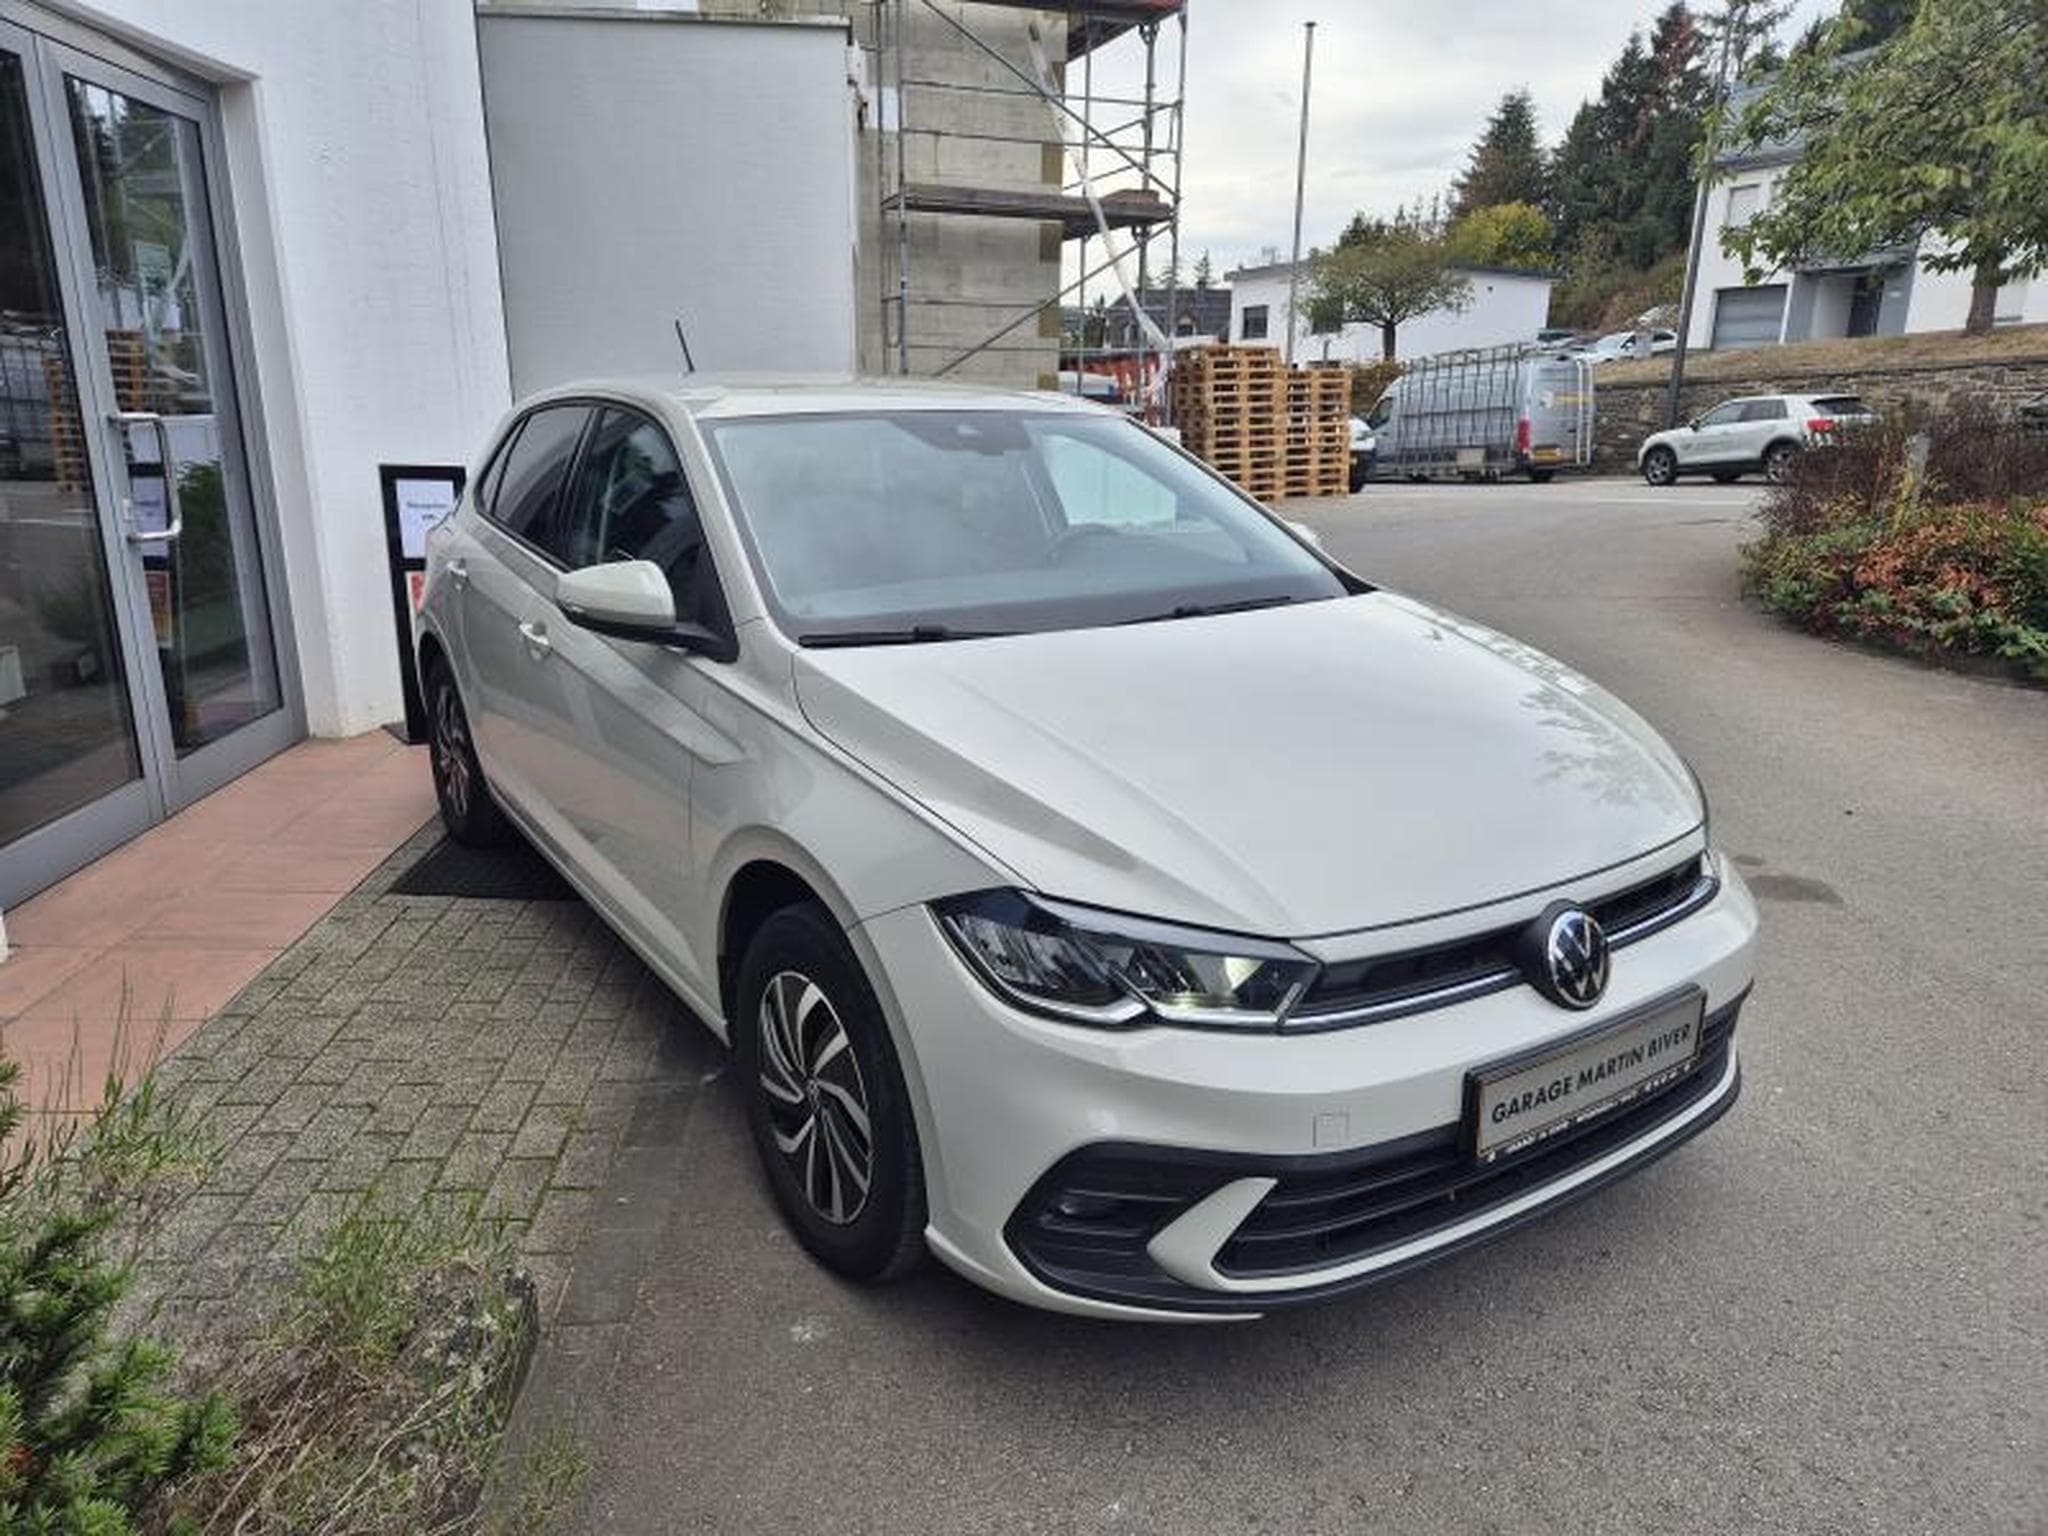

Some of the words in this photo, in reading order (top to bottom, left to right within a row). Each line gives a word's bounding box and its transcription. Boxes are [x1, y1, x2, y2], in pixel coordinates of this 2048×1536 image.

[1492, 1076, 1573, 1124] GARAGE
[1577, 1045, 1645, 1091] MARTIN
[1647, 1023, 1691, 1058] BIVER
